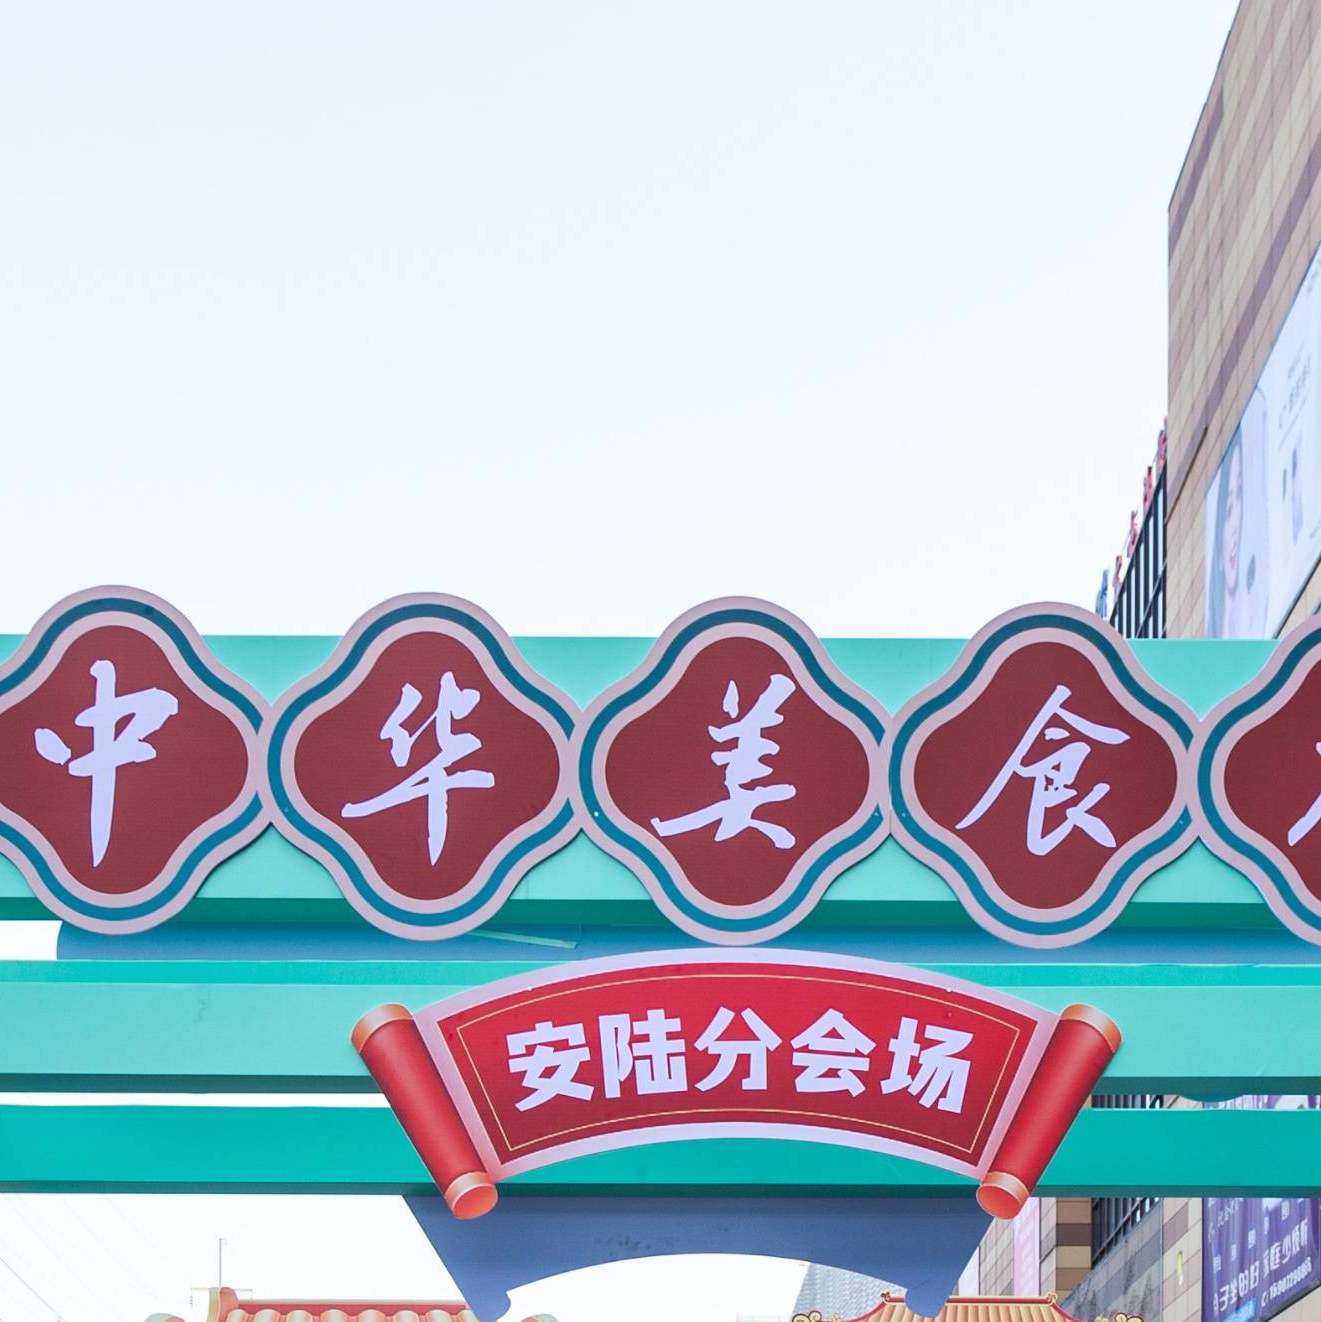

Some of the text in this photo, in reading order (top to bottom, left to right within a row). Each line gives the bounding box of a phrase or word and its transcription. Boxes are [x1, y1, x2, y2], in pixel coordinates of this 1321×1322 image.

[505, 1007, 975, 1114] 安陆分会场
